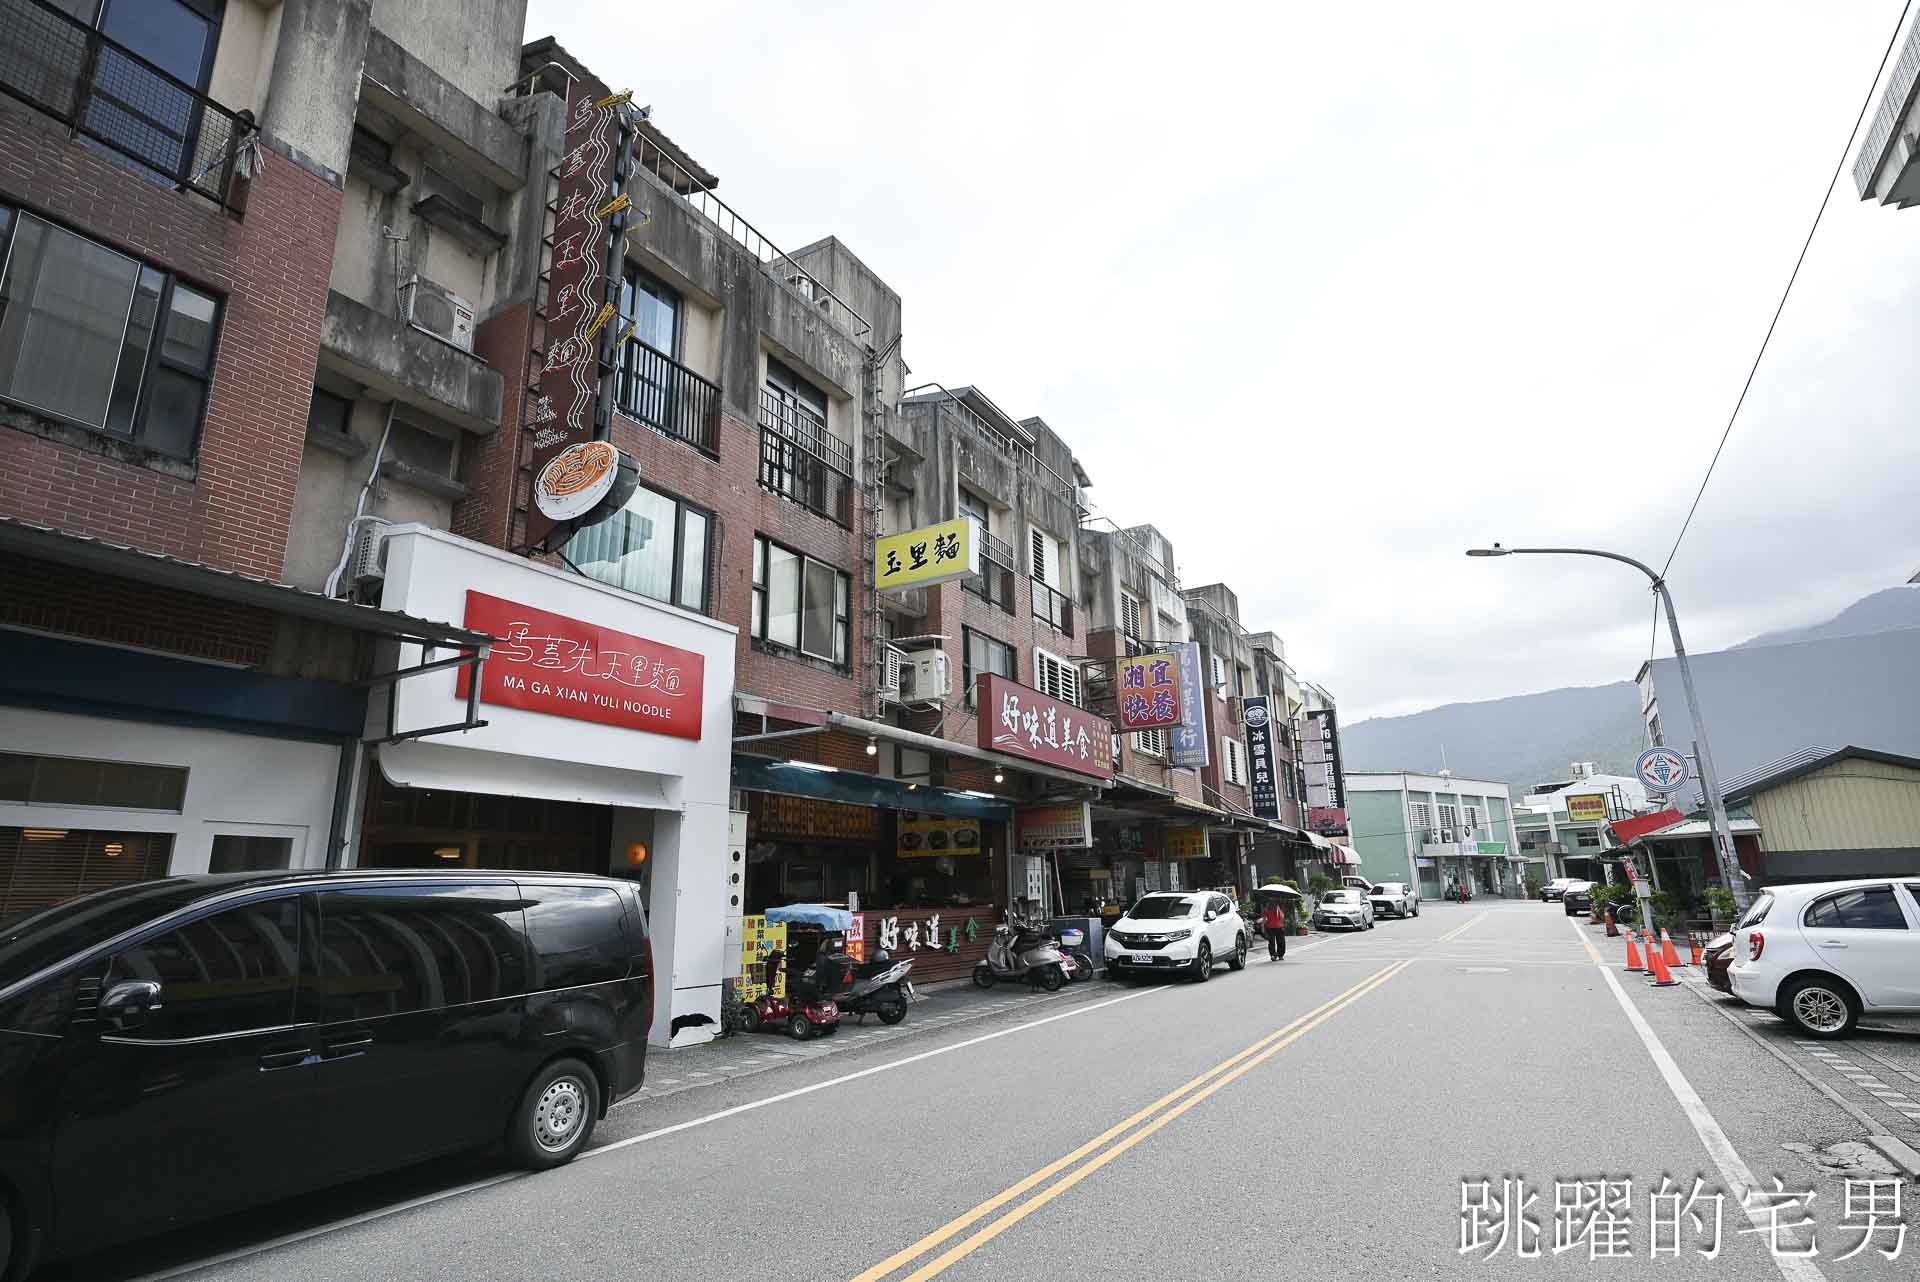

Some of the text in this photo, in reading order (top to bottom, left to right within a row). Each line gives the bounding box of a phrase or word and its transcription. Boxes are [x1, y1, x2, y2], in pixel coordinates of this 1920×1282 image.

[883, 533, 960, 577] 玉里麵
[504, 675, 672, 719] MA GA XIAN YULI NOODLE
[1124, 690, 1175, 721] 快餐
[1001, 689, 1091, 760] 好味道美食
